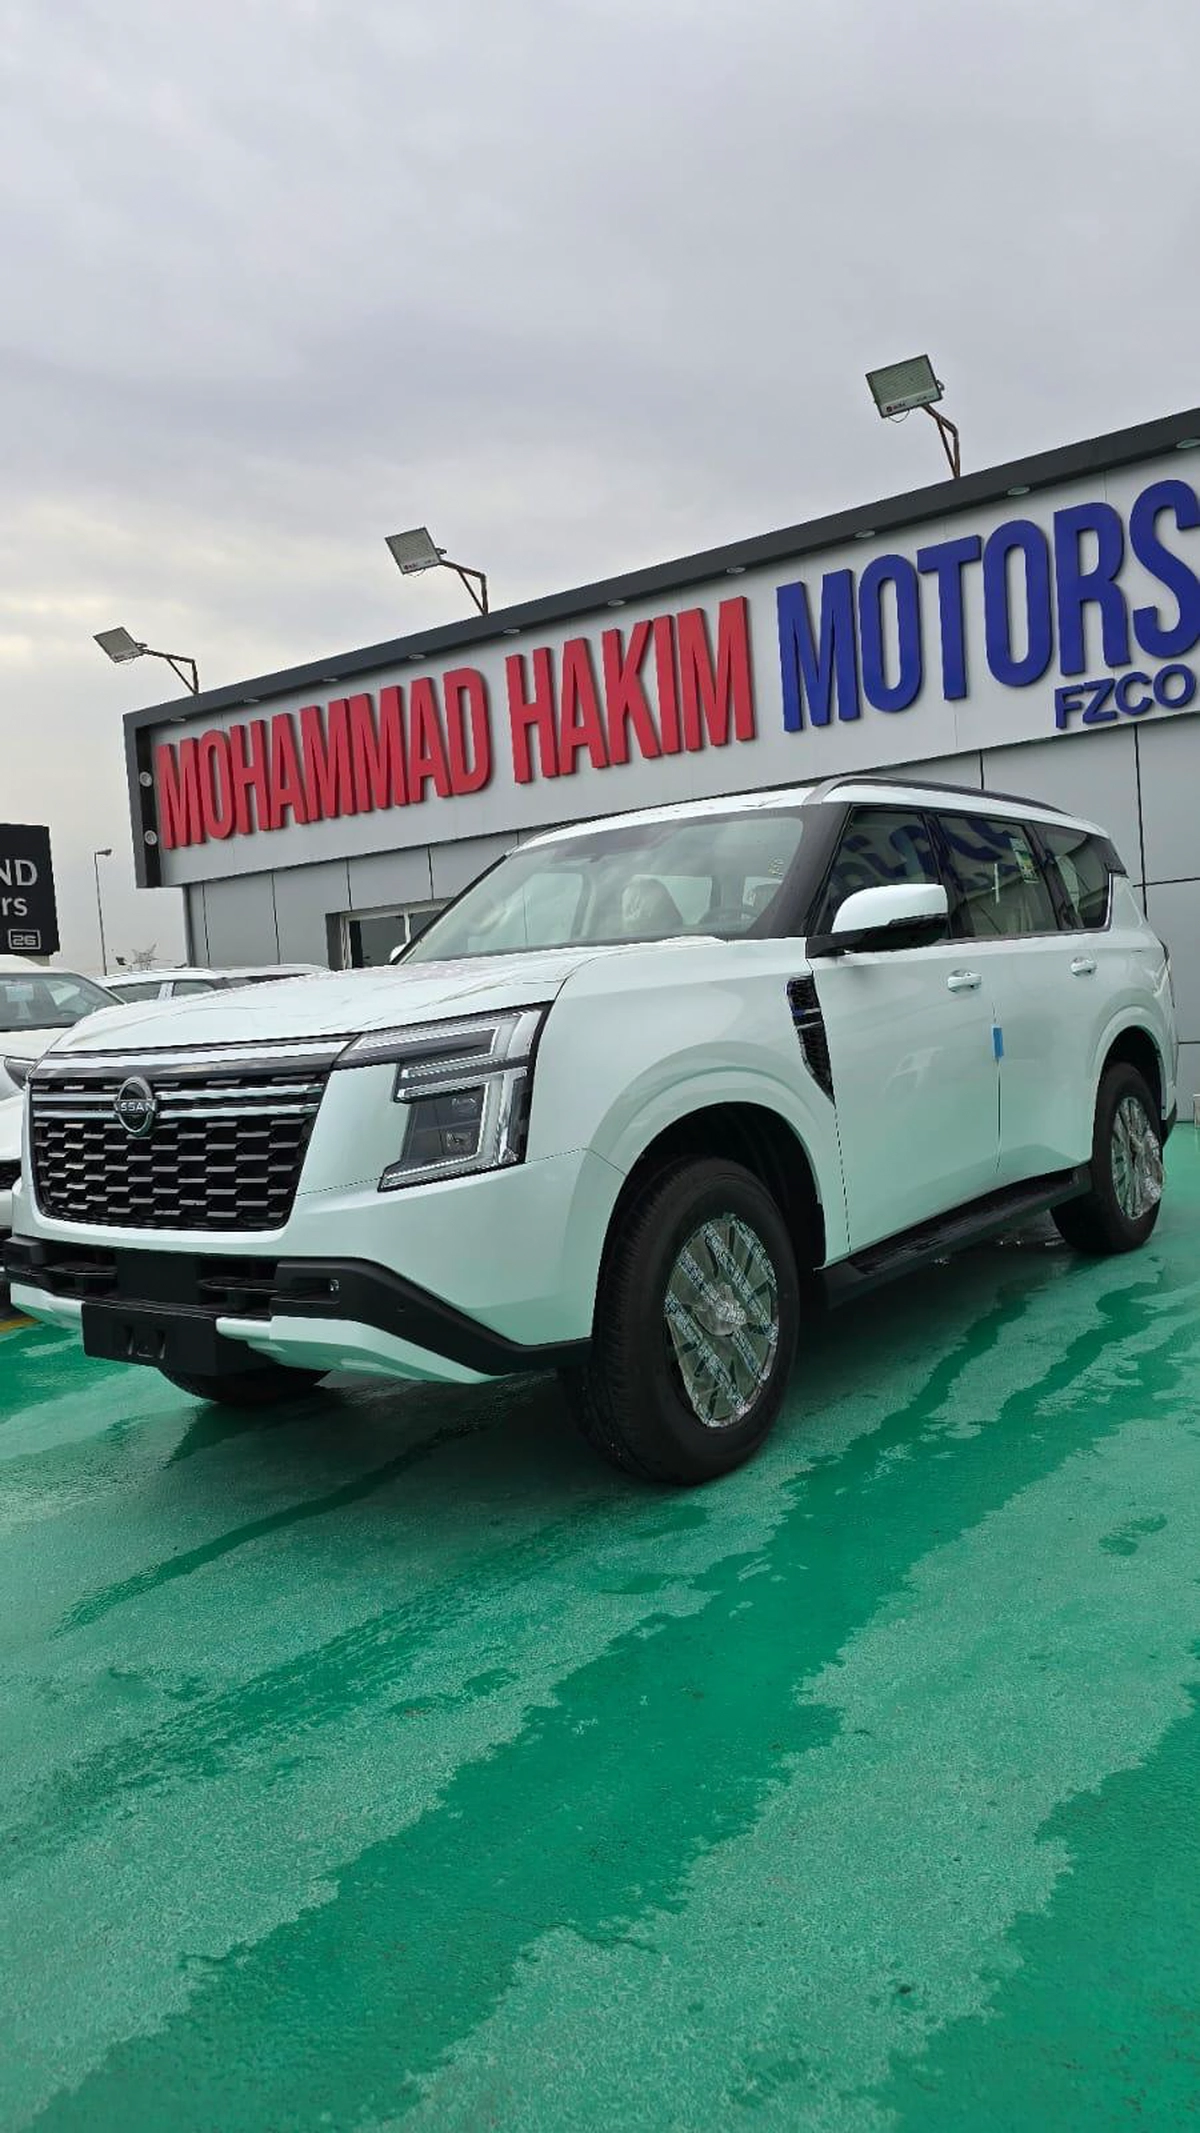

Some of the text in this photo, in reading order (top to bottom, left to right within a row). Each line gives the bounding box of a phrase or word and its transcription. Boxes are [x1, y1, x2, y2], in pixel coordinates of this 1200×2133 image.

[156, 479, 1200, 850] MOHAMMAD HAKIM MOTORS
[1054, 663, 1197, 730] FZCO
